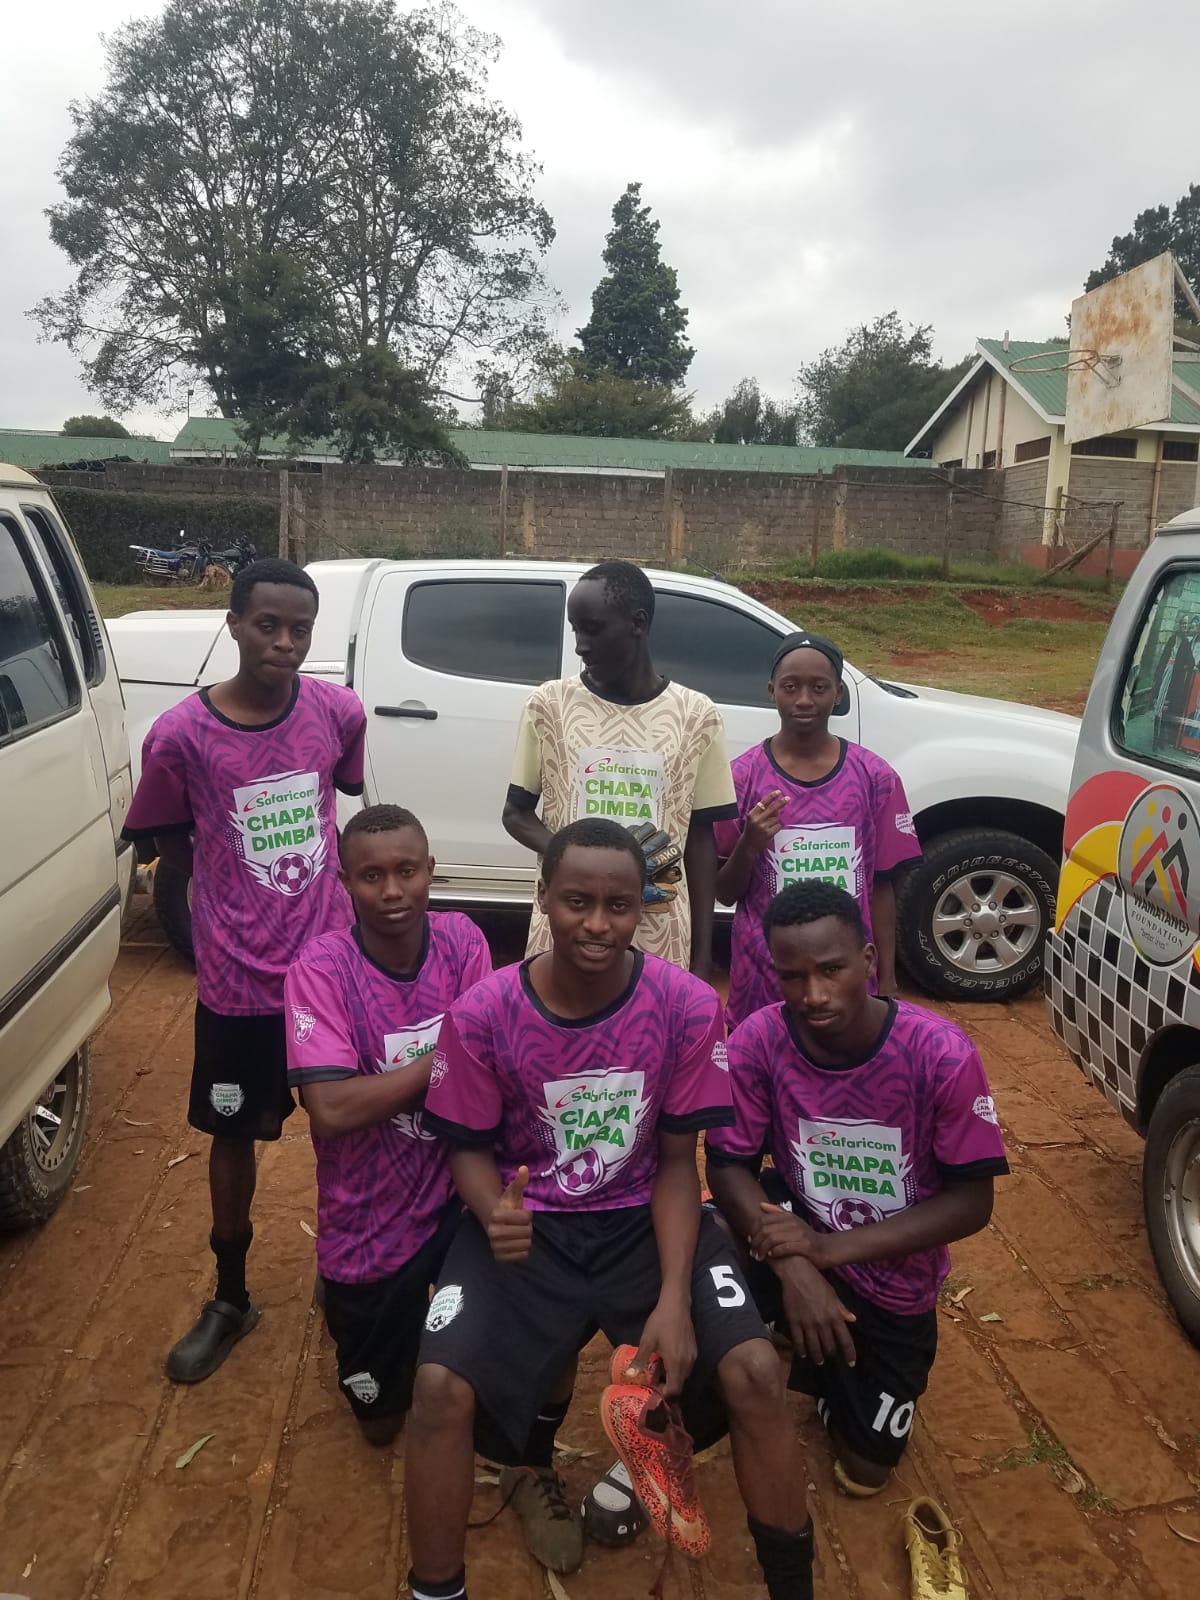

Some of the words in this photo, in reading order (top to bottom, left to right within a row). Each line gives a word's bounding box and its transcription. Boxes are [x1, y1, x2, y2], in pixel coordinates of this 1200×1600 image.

[598, 762, 657, 777] Safaricom
[255, 788, 315, 808] Safaricom
[585, 780, 653, 799] CHAPA
[246, 805, 316, 832] CHAPA
[585, 799, 652, 818] DIMBA
[251, 825, 315, 852] DIMBA
[792, 839, 850, 851] Safaricom
[655, 847, 678, 865] JAKO
[781, 856, 849, 873] CHAPA
[1133, 892, 1190, 937] WAMATANGI
[1131, 910, 1183, 948] FOUNDATION
[821, 1136, 897, 1152] Safaricom
[808, 1150, 897, 1177] CHAPA
[813, 1170, 897, 1198] DIMBA
[709, 1265, 746, 1307] 5
[872, 1391, 915, 1438] 10
